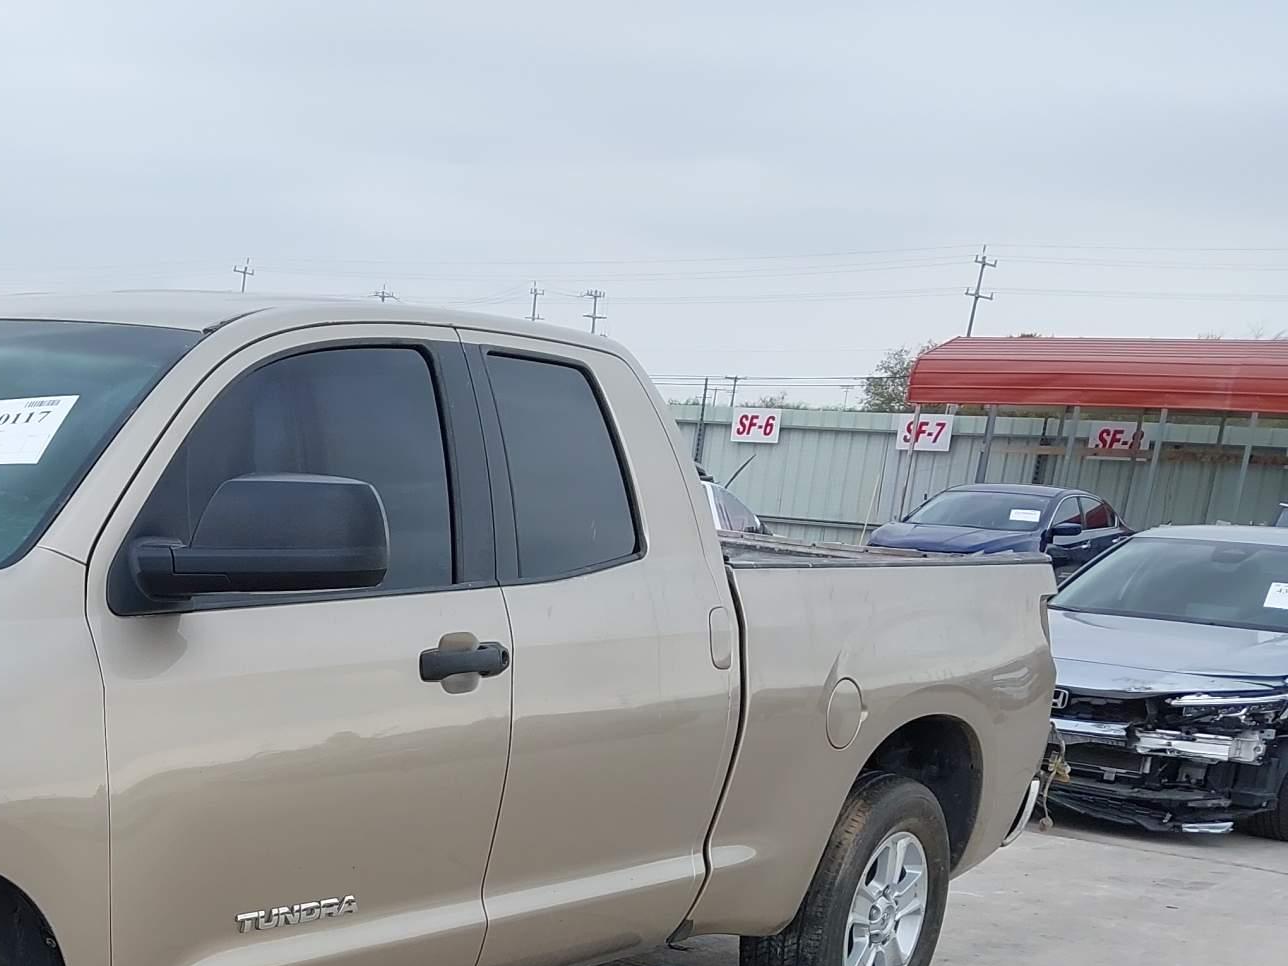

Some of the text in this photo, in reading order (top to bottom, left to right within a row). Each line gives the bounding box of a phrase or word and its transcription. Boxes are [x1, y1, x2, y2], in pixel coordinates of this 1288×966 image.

[736, 414, 776, 436] SF-6
[903, 421, 947, 443] SF-7
[235, 895, 359, 933] TUNDRA
